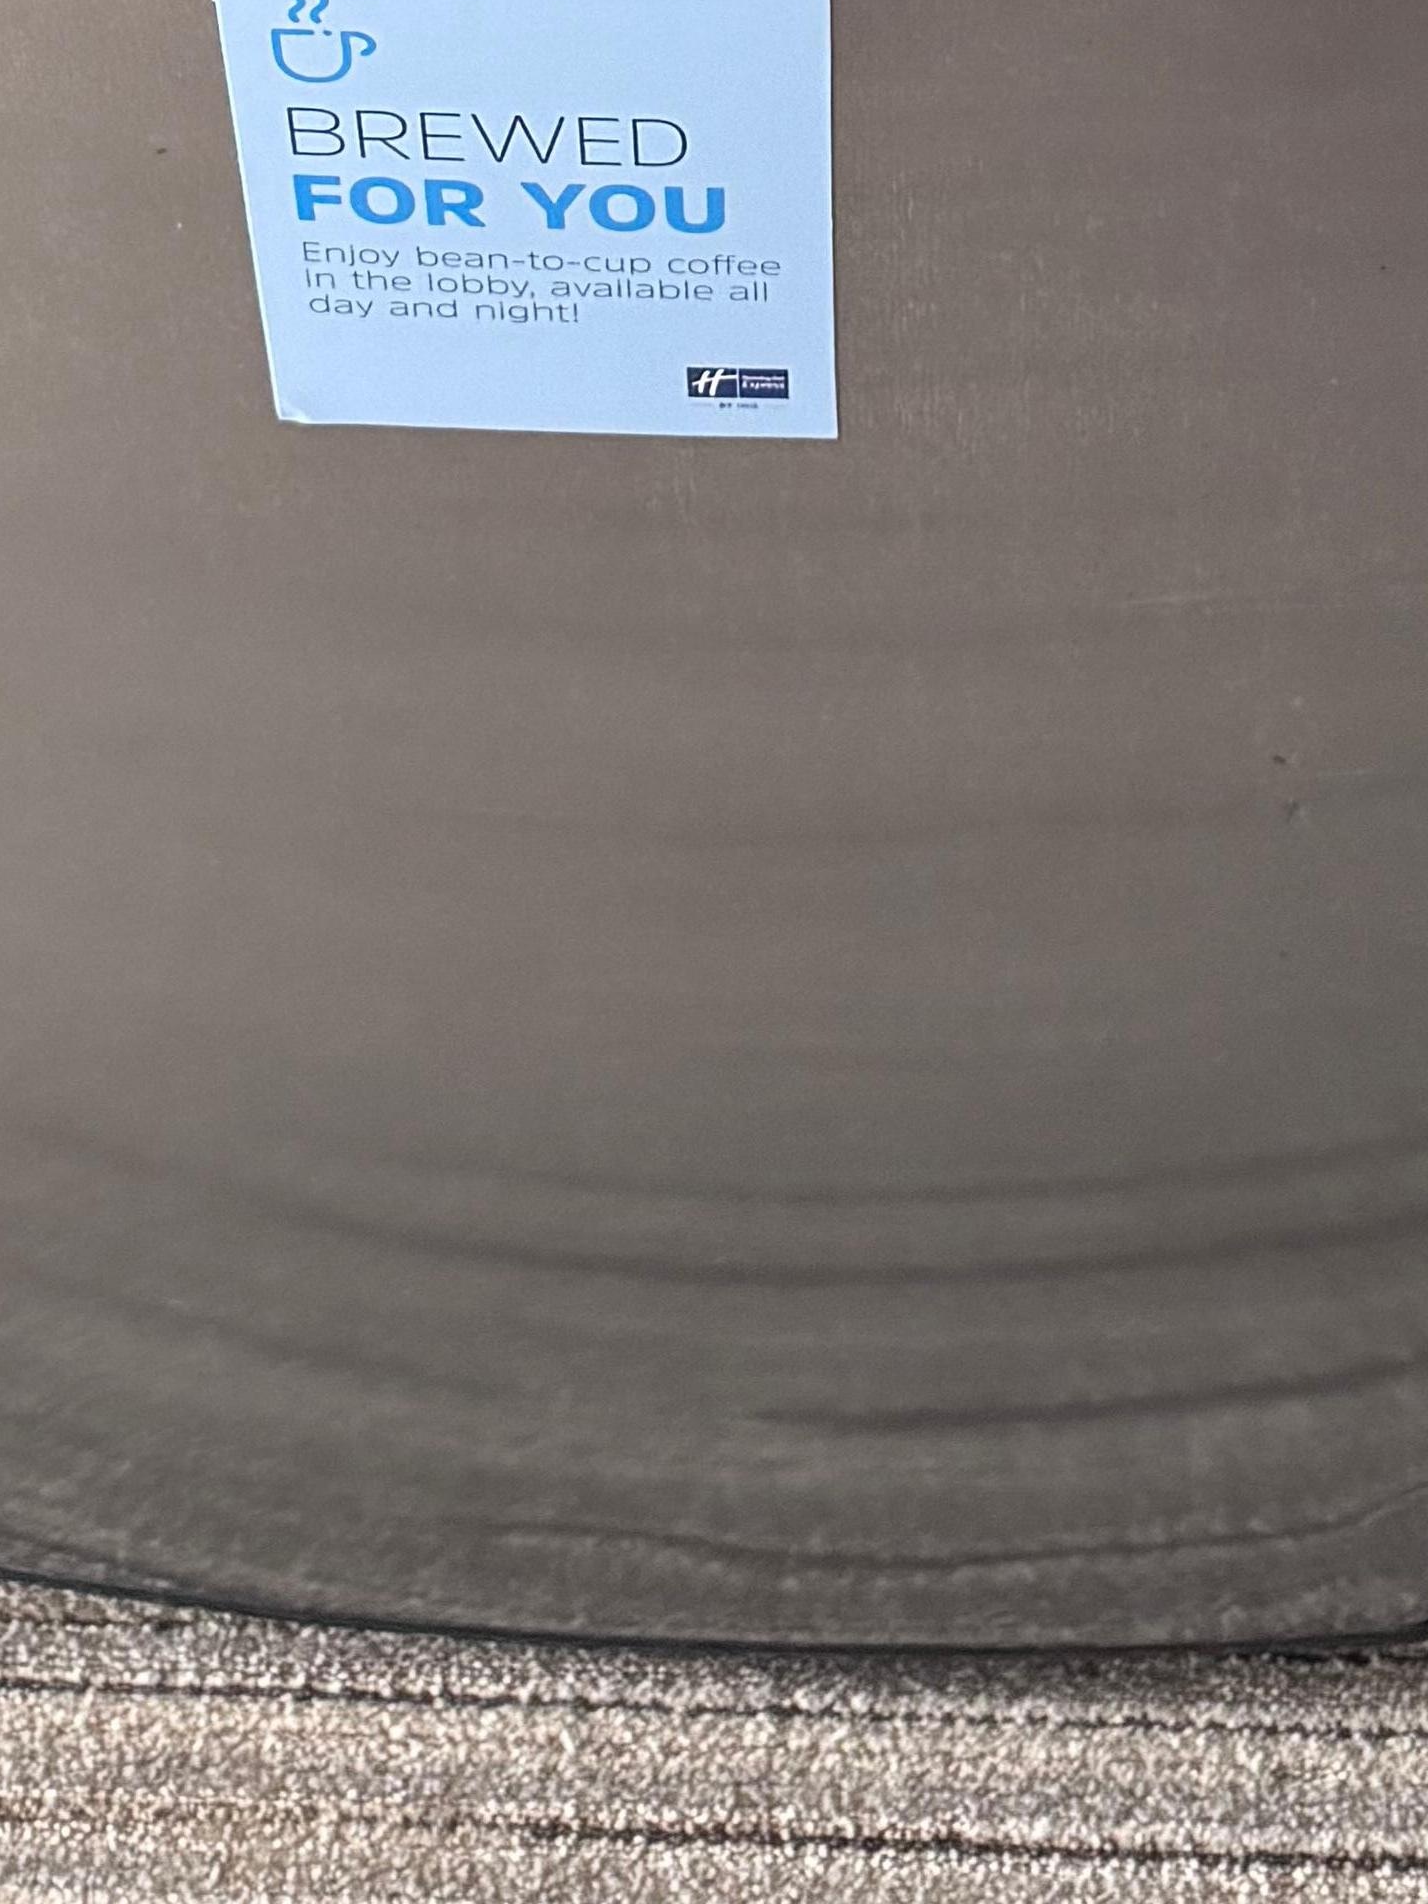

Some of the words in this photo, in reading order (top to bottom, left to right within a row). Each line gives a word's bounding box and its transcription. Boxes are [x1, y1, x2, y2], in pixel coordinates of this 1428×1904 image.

[287, 106, 689, 167] BREWED
[293, 173, 486, 228] FOR
[520, 181, 727, 234] YOU
[303, 240, 400, 268] Enjoy
[416, 245, 652, 276] bean-to-cup
[667, 254, 781, 276] coffee
[306, 267, 336, 289] in
[352, 269, 412, 292] the
[428, 272, 535, 299] lobby,
[550, 278, 714, 302] available
[729, 280, 769, 303] all
[309, 294, 373, 318] day
[389, 299, 459, 318] and
[475, 301, 580, 324] night!
